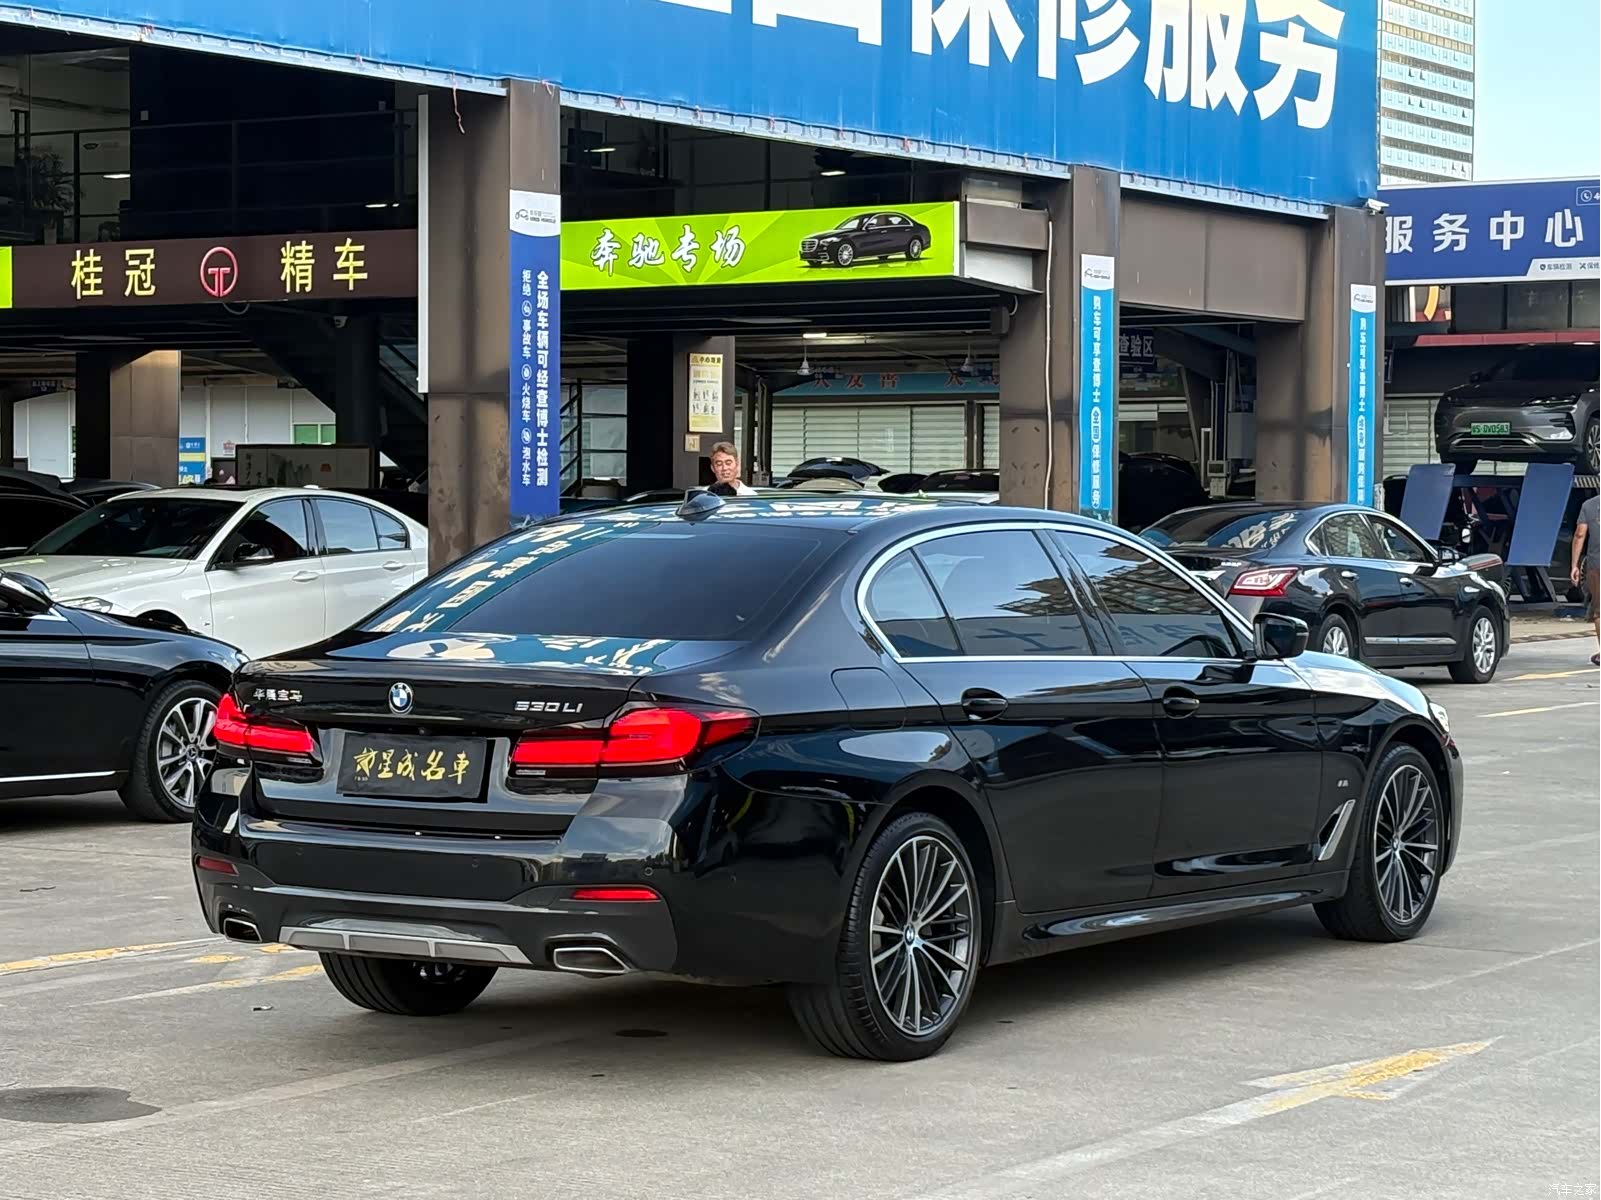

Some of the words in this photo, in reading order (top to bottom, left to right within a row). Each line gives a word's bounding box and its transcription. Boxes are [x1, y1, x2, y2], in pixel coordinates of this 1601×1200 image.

[589, 223, 746, 277] 奔驰专场
[1385, 208, 1584, 254] 服务中心
[71, 248, 156, 300] 桂冠
[280, 237, 368, 293] 精车
[522, 269, 532, 296] 拒绝
[522, 319, 532, 359] 事故车
[536, 270, 549, 487] 全场车辆可经查博士检测
[521, 382, 531, 423] 火烧车
[253, 688, 303, 703] 华晨宝马
